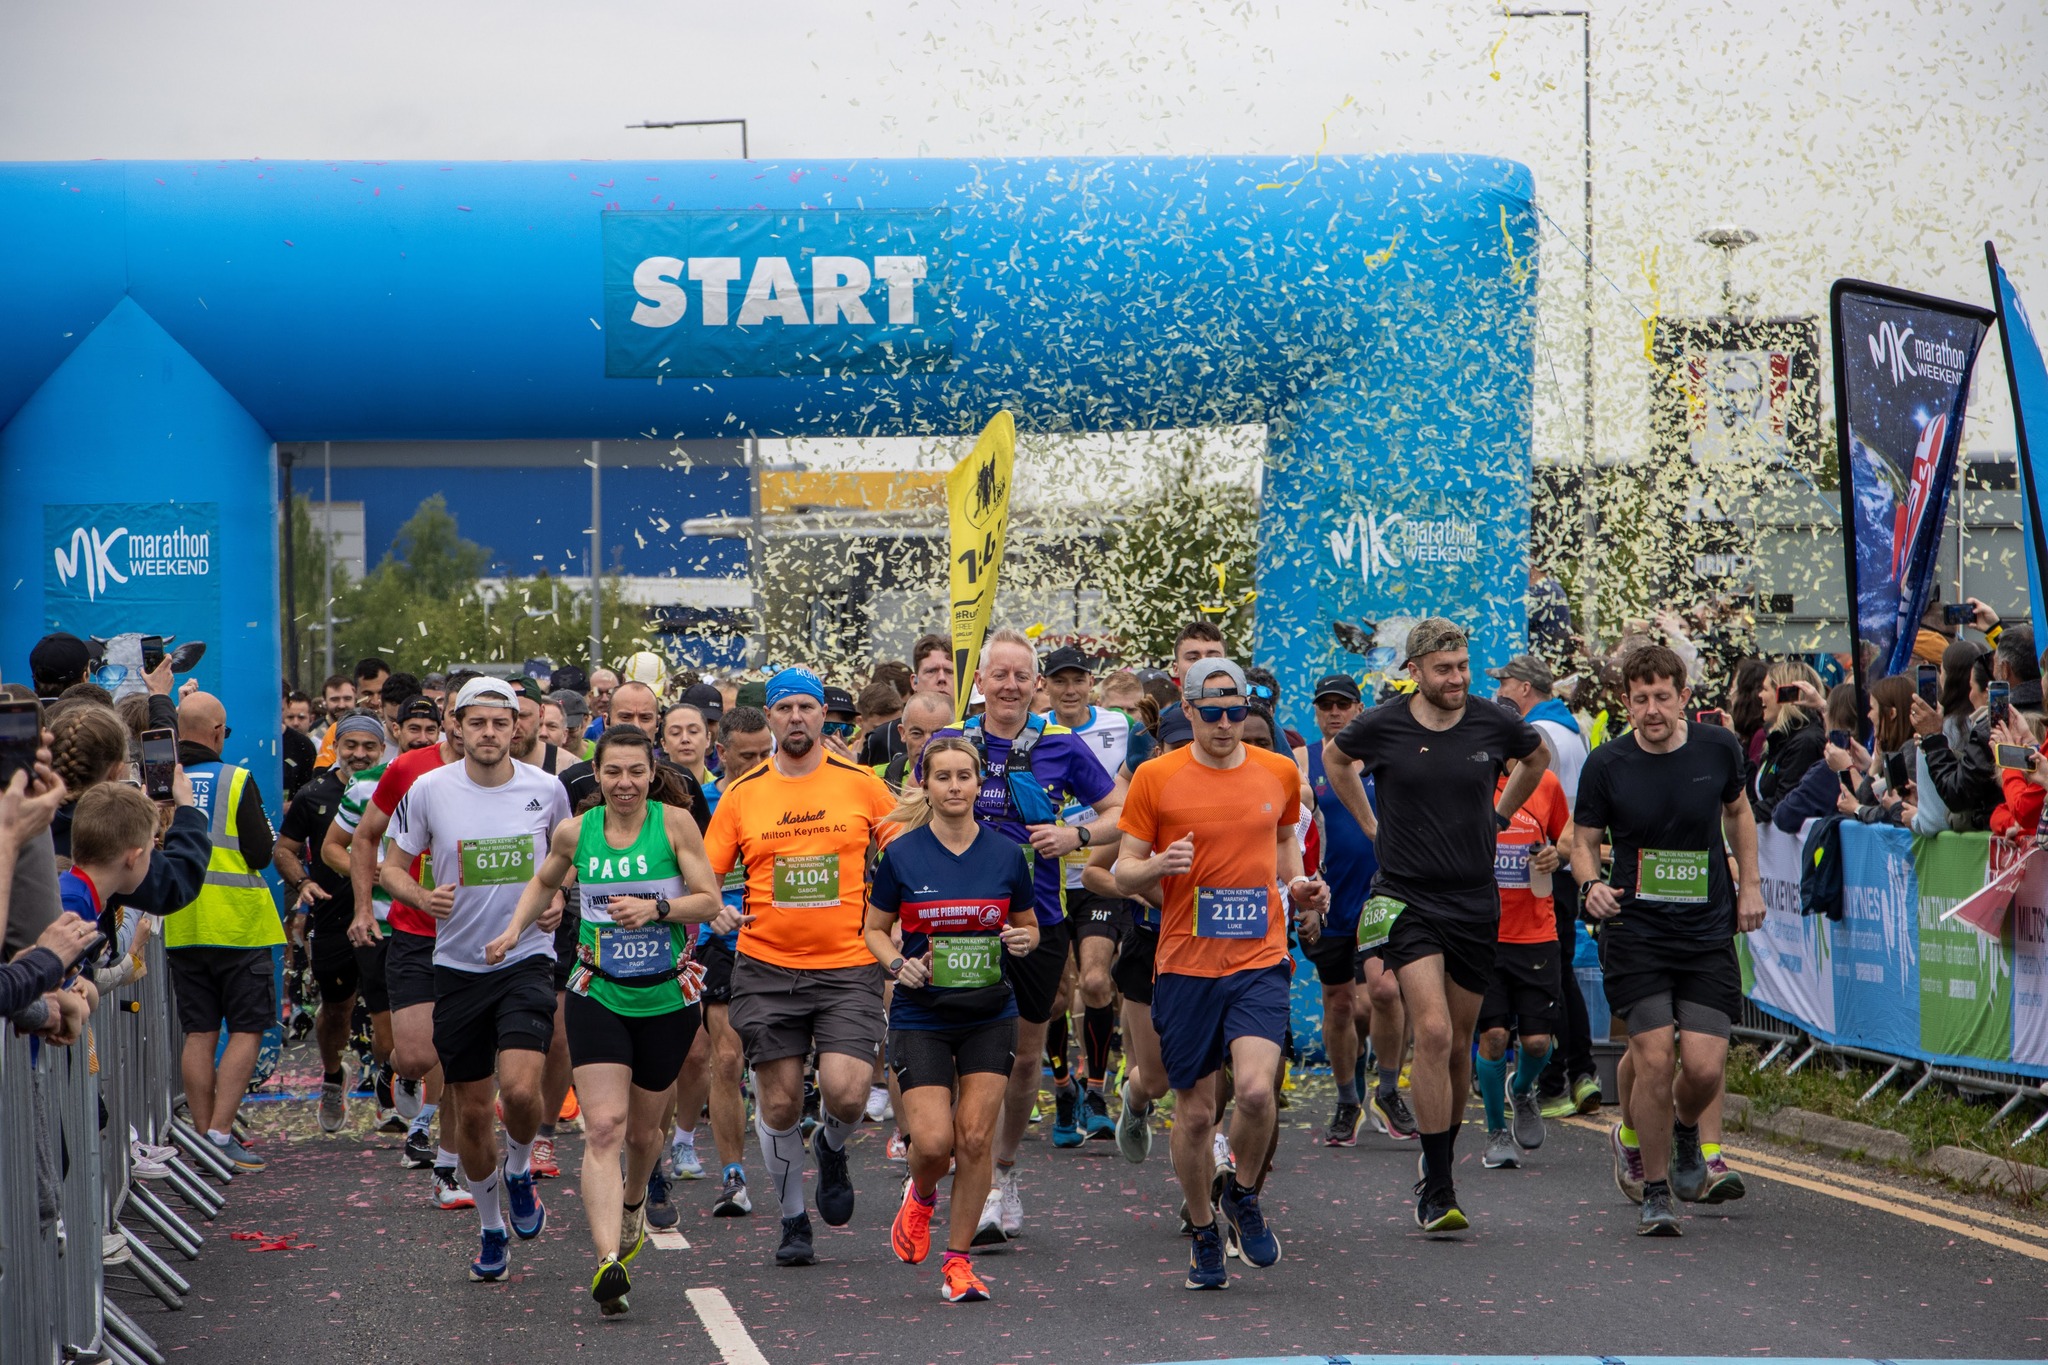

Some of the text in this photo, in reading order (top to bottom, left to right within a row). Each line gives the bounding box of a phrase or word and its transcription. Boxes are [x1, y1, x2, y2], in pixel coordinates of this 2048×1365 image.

[630, 255, 927, 328] START
[1868, 321, 1918, 387] MK
[1914, 338, 1965, 370] marathon
[1403, 513, 1477, 545] marathon
[129, 525, 209, 558] marathon
[1331, 511, 1402, 585] MK
[1403, 545, 1477, 562] WEEKEND
[54, 526, 128, 603] MK
[129, 559, 209, 576] WEEKEND
[776, 809, 826, 826] Marshall
[761, 824, 847, 841] Milton Keynes AC
[476, 851, 522, 869] 6178
[589, 854, 648, 879] PAGS
[784, 868, 829, 886] 4104
[1655, 864, 1698, 881] 6189
[918, 906, 981, 919] HOLME PIERREPONT
[1211, 903, 1258, 920] 2112
[1364, 908, 1388, 927] 6188
[931, 918, 968, 927] NOTTINGHAM
[612, 940, 659, 960] 2032
[947, 952, 991, 969] 6071
